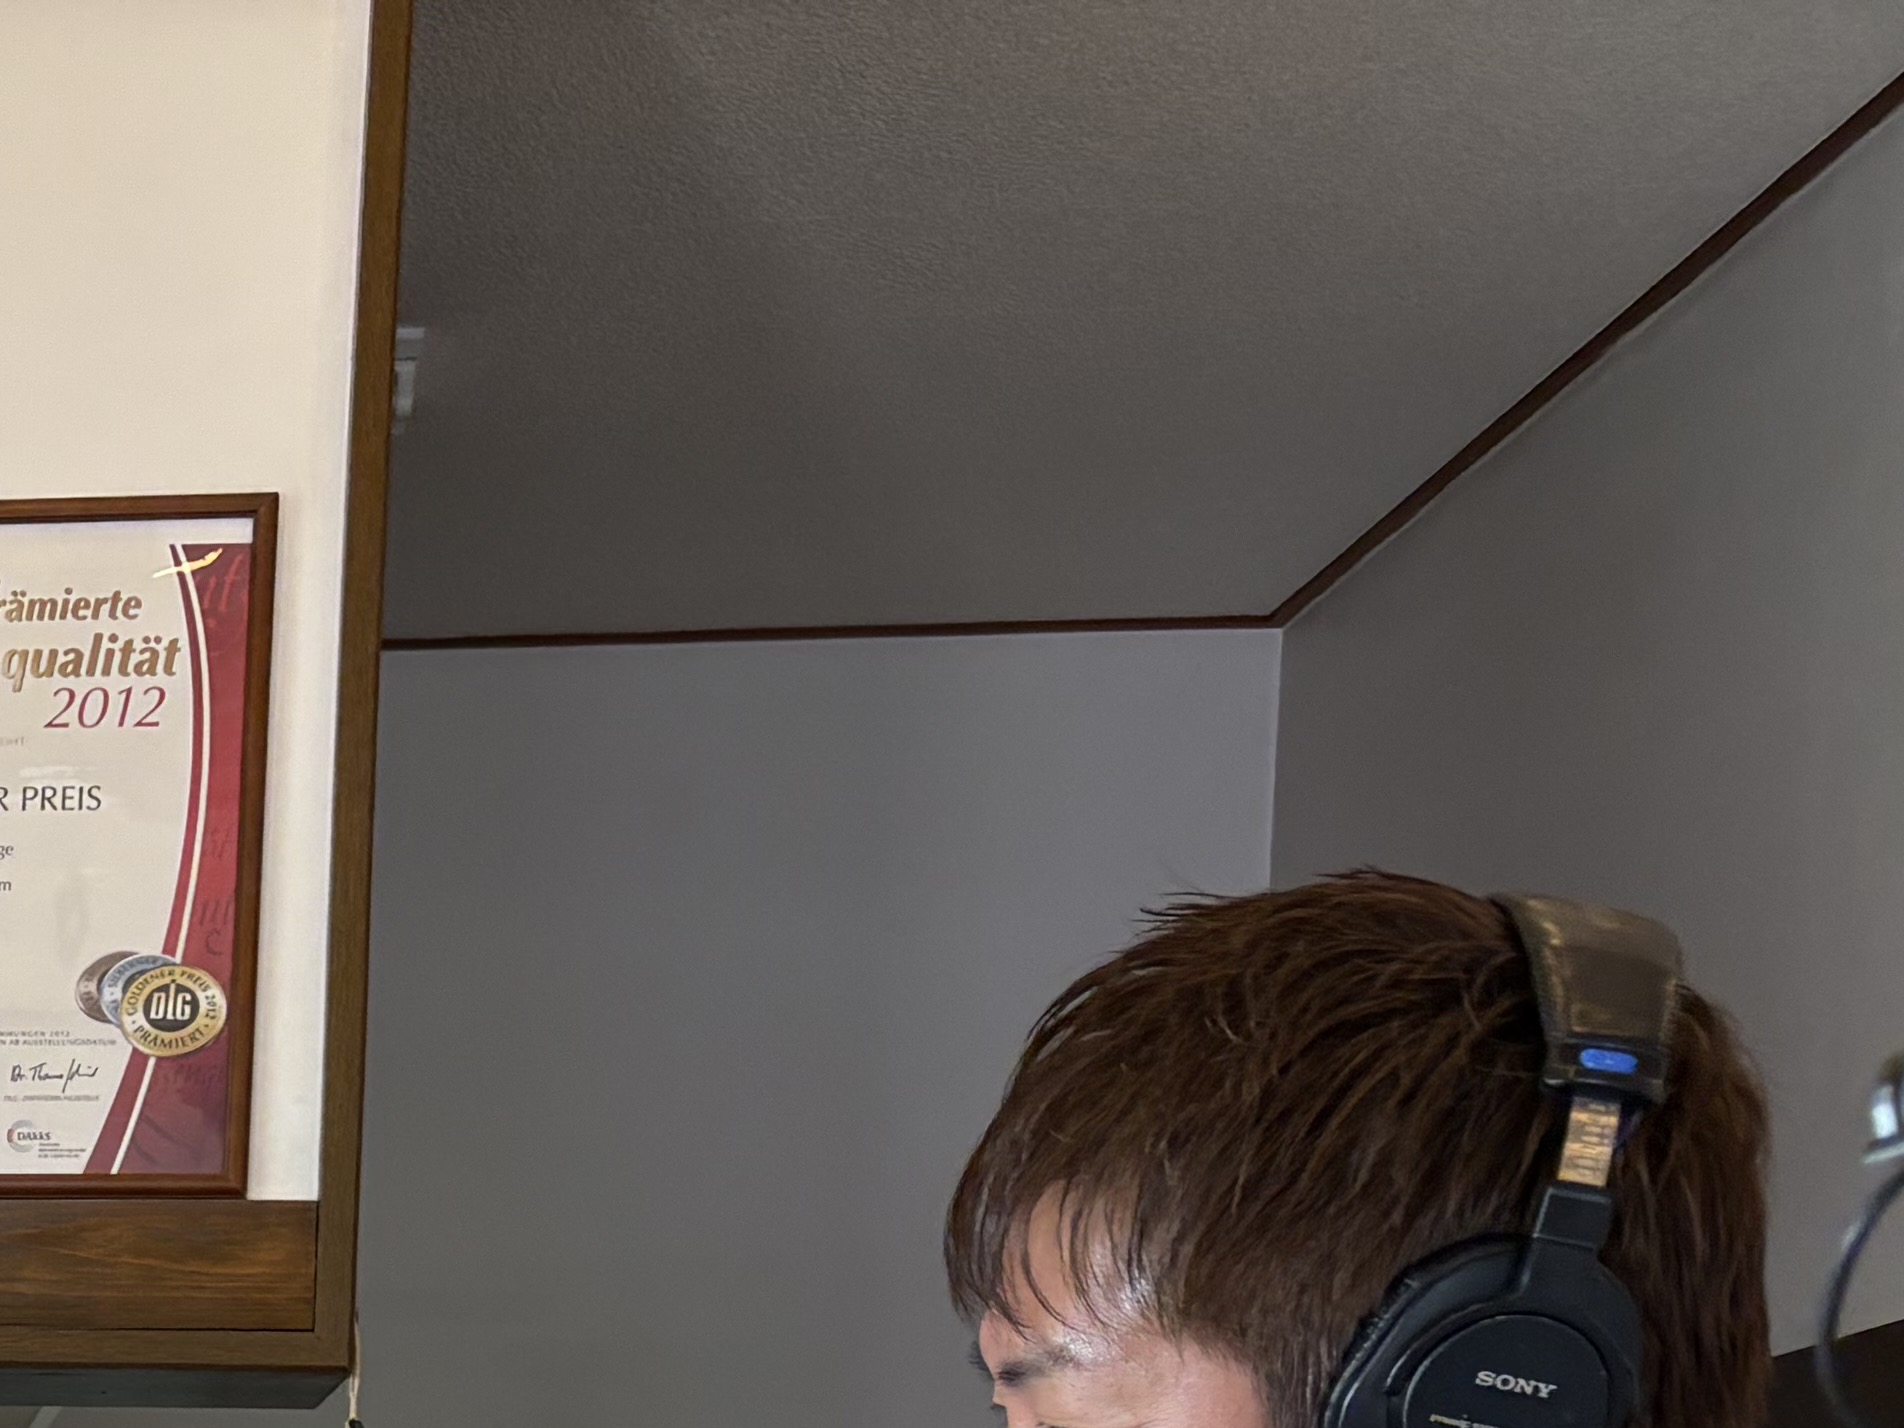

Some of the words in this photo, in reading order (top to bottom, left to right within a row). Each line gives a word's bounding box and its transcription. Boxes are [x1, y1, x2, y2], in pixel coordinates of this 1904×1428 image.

[43, 686, 167, 729] 2012
[21, 784, 103, 812] PREIS
[1474, 1369, 1559, 1400] SONY
